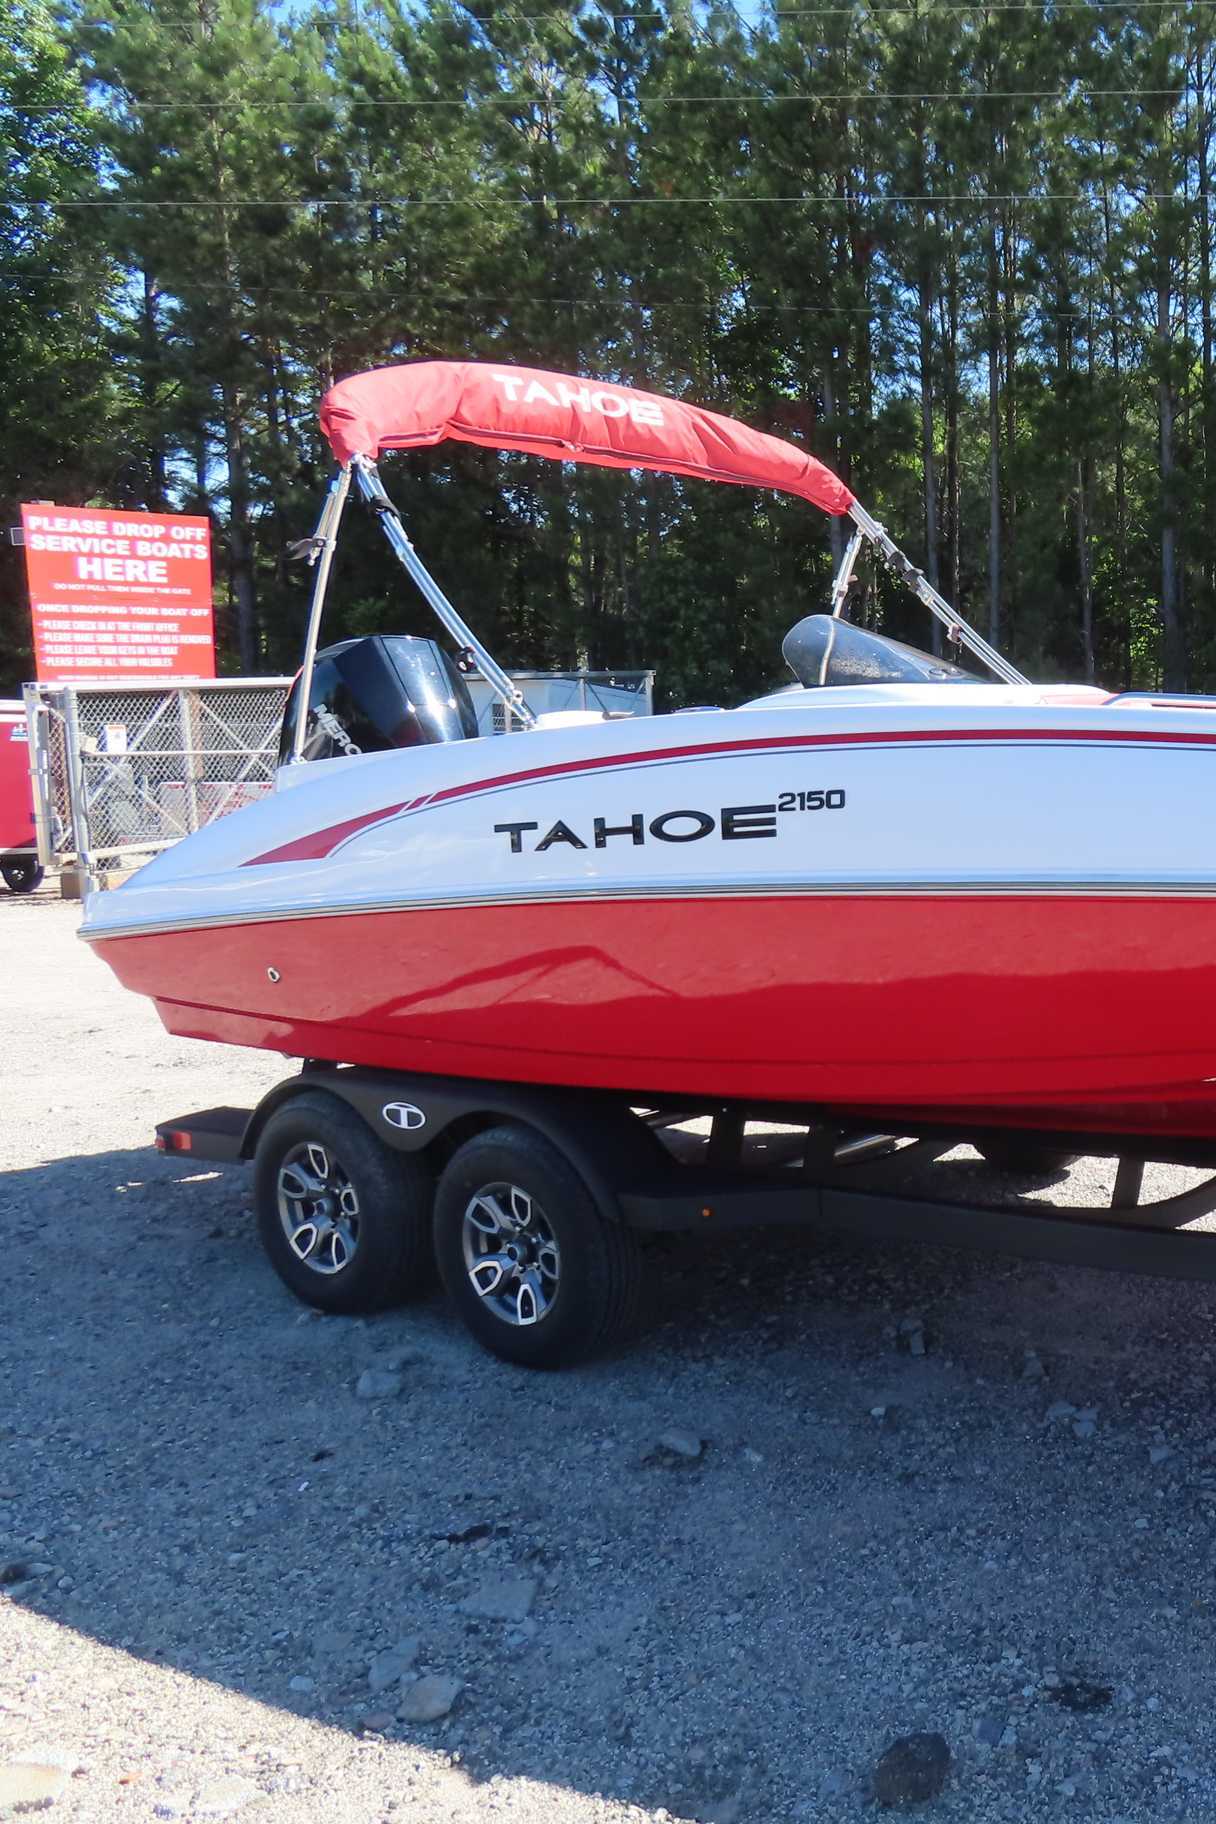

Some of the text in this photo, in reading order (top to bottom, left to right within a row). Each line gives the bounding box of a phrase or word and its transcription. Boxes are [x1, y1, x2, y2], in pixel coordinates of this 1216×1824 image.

[492, 373, 664, 427] TAHOE
[28, 516, 207, 541] PLEASE DROP OFF
[30, 534, 208, 560] SERVICE BOATS
[77, 556, 168, 583] HERE
[37, 603, 209, 617] ONCE DROPPING YOUR BOAT OFF
[494, 789, 846, 853] TAHOE 2150
